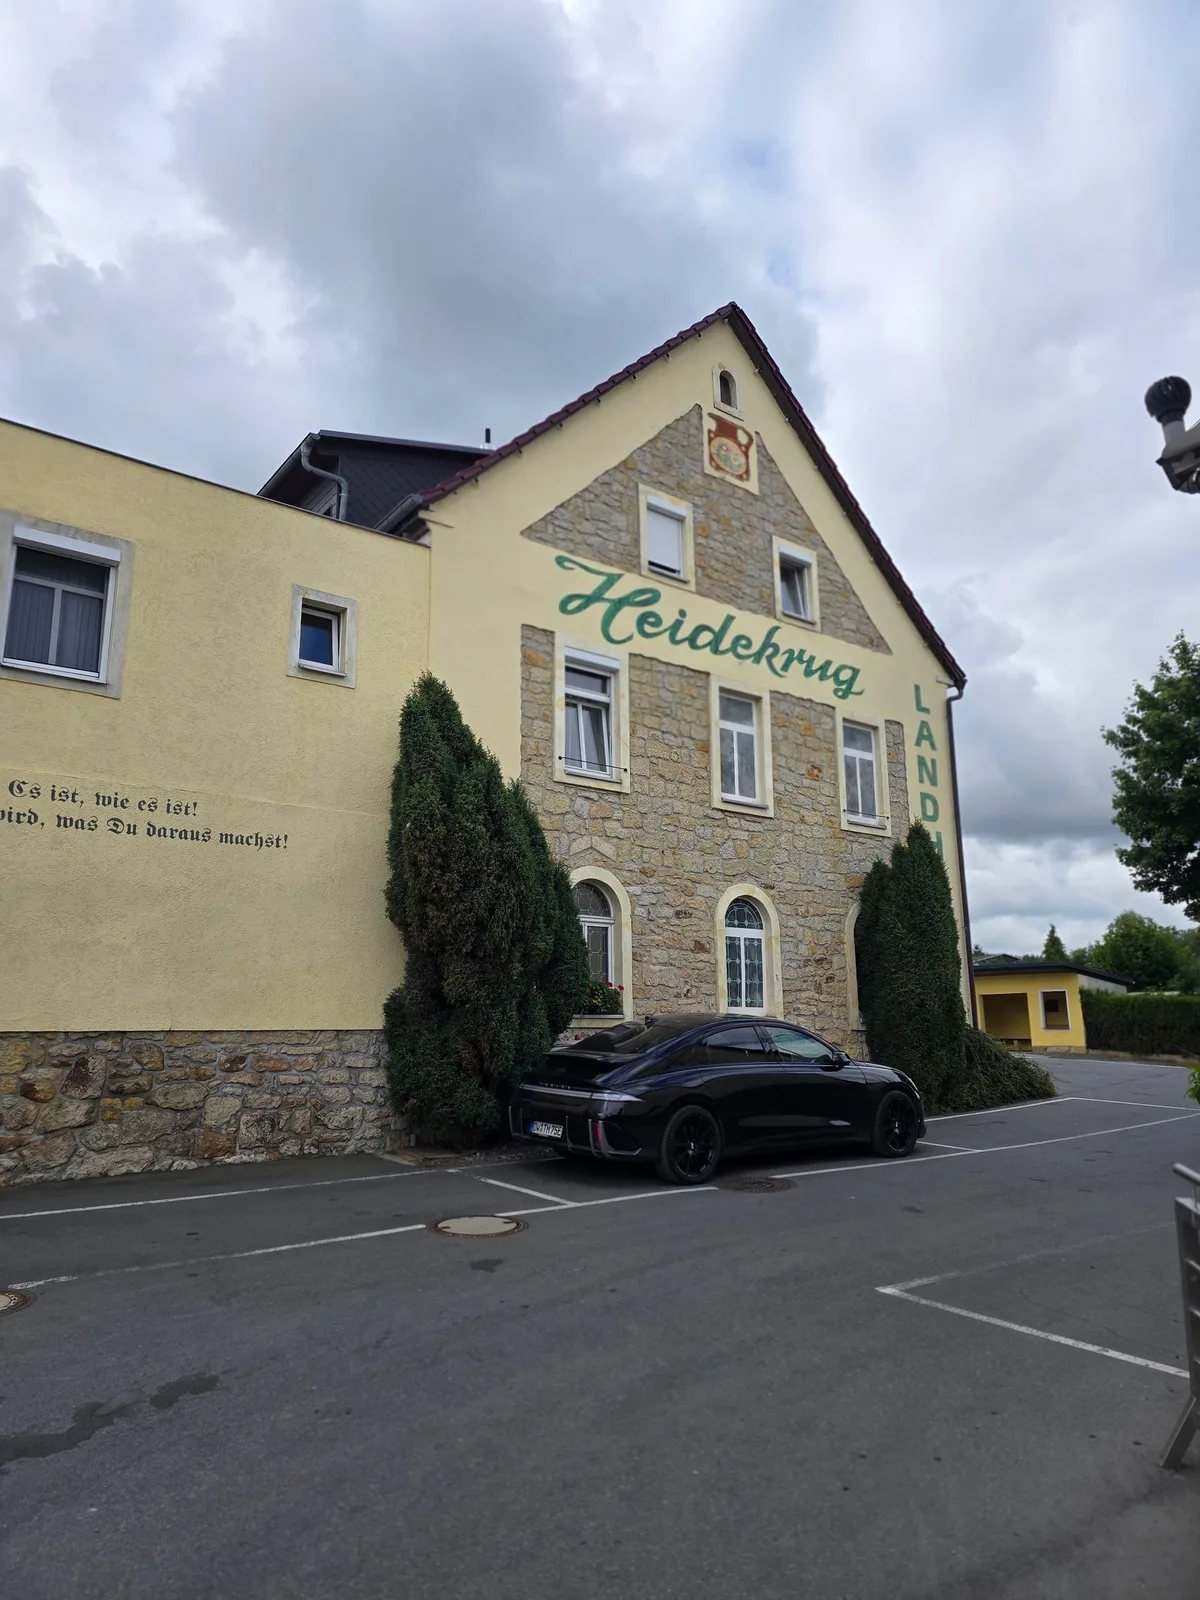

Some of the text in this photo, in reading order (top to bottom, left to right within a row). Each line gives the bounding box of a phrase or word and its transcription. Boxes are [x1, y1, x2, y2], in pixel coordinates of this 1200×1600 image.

[554, 554, 865, 701] Heidekrug
[8, 779, 199, 817] Es ist, wie es ist!
[55, 813, 99, 832] was
[106, 817, 138, 836] Du
[145, 820, 213, 843] daraus
[218, 831, 289, 852] machst!
